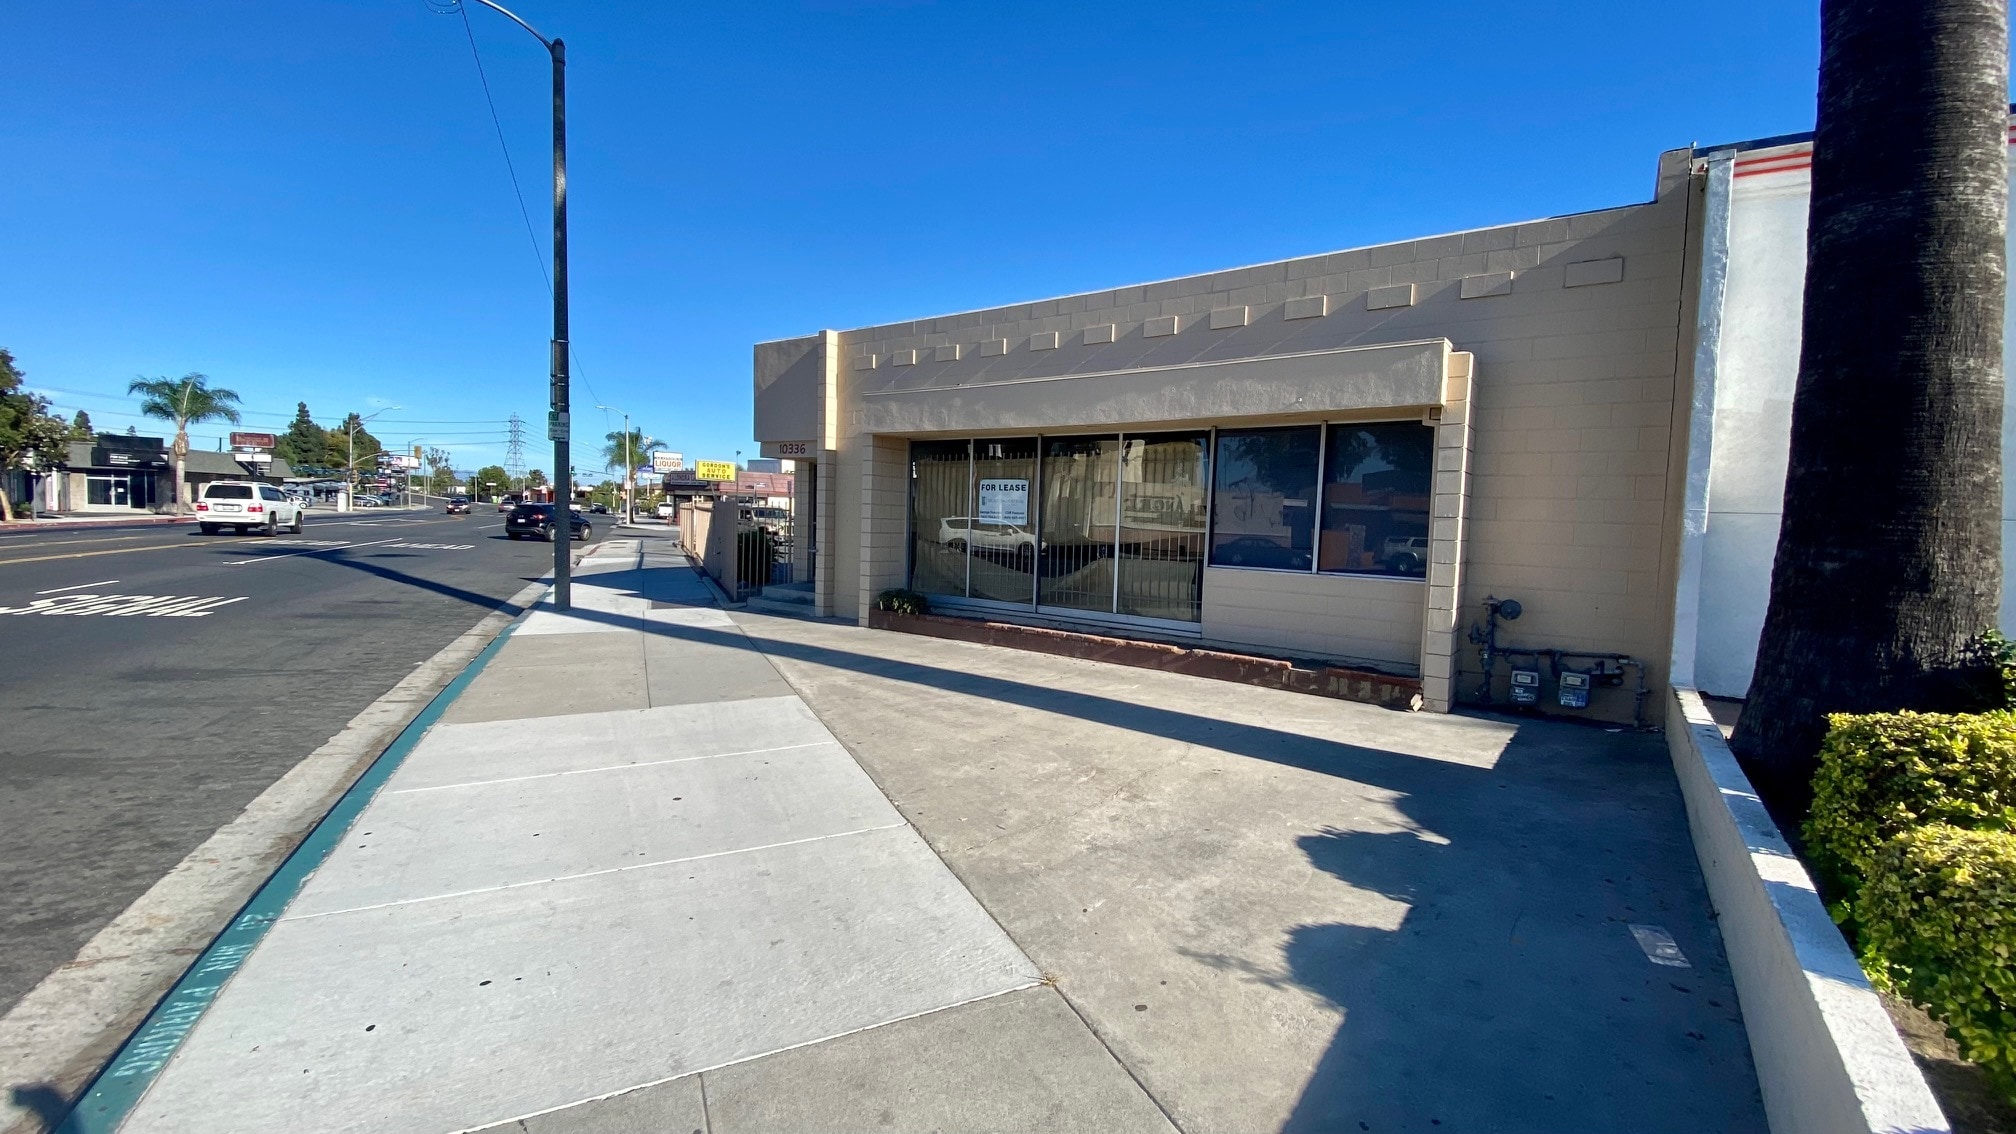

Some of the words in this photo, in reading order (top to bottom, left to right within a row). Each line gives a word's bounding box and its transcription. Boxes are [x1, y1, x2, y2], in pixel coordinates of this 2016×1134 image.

[779, 443, 806, 454] 10336
[655, 460, 682, 468] LIQUOR
[981, 483, 996, 491] FOR
[998, 483, 1027, 491] LEASE
[0, 595, 249, 616] SIGNAL
[112, 986, 219, 1078] PARKING
